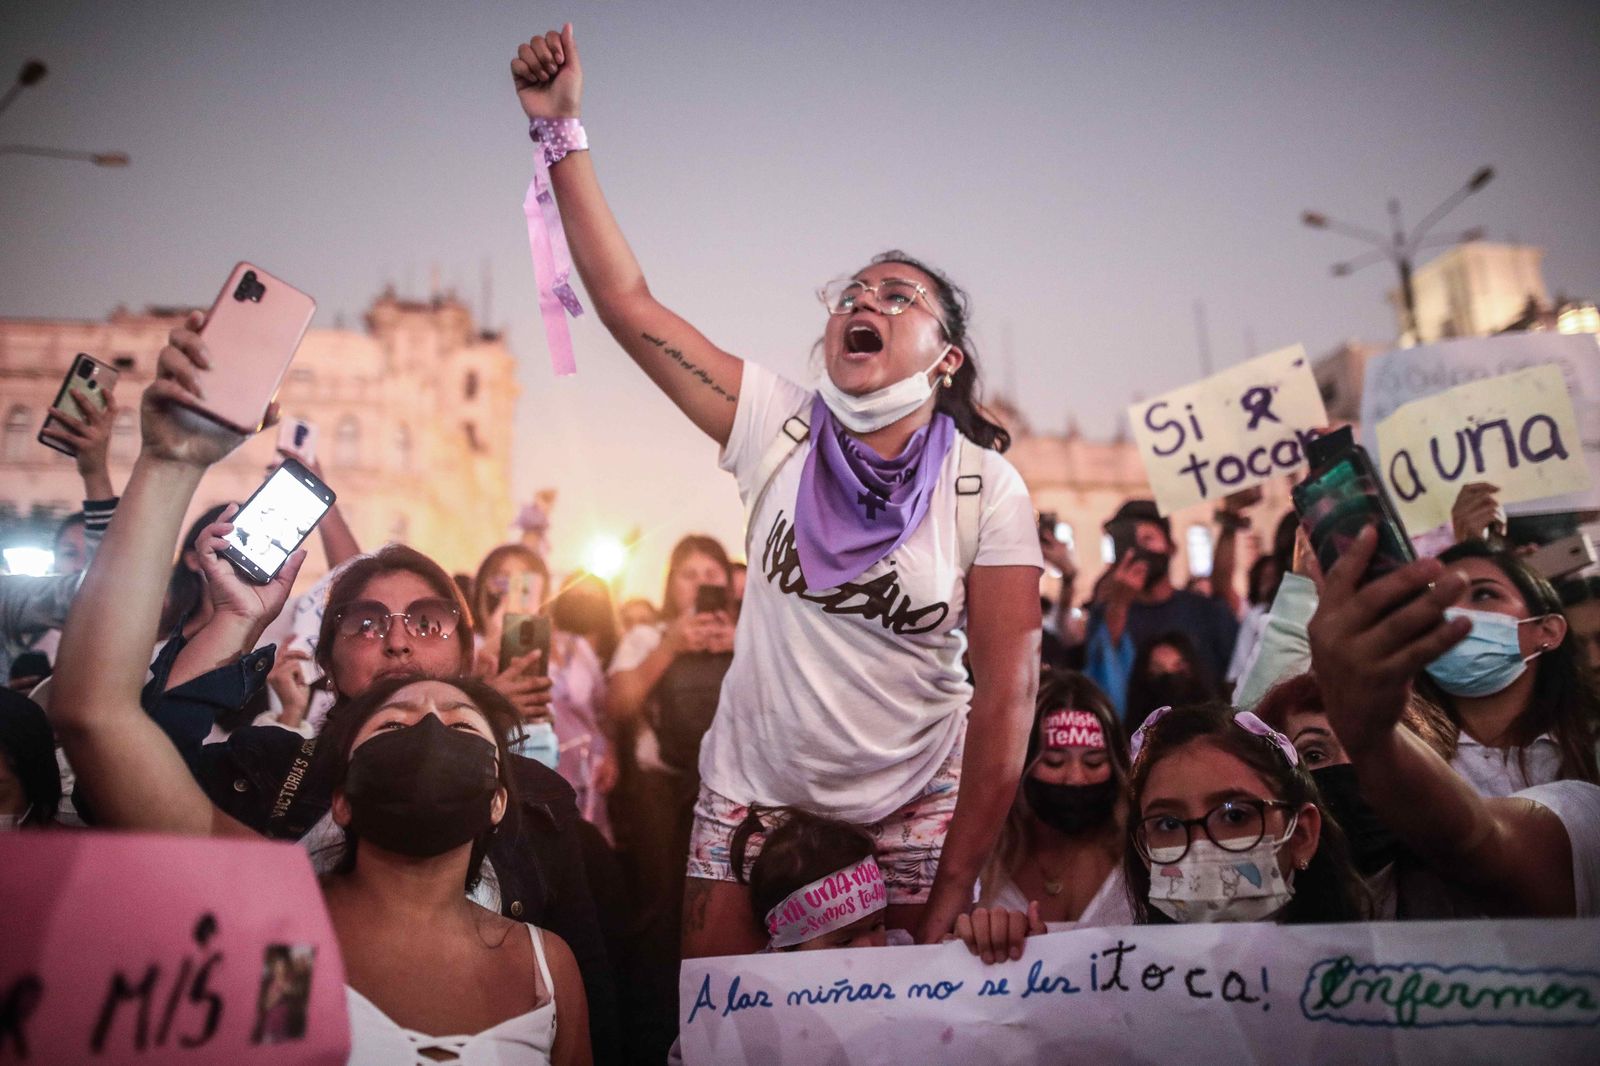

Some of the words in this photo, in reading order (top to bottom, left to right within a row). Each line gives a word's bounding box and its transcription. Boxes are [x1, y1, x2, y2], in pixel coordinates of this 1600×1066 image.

[1144, 401, 1204, 458] Si
[1389, 449, 1426, 502] a
[687, 973, 717, 1024] A
[722, 976, 773, 1017] las
[786, 977, 896, 1006] niñas
[907, 978, 964, 1001] no
[977, 977, 1010, 997] se
[1021, 959, 1081, 998] les
